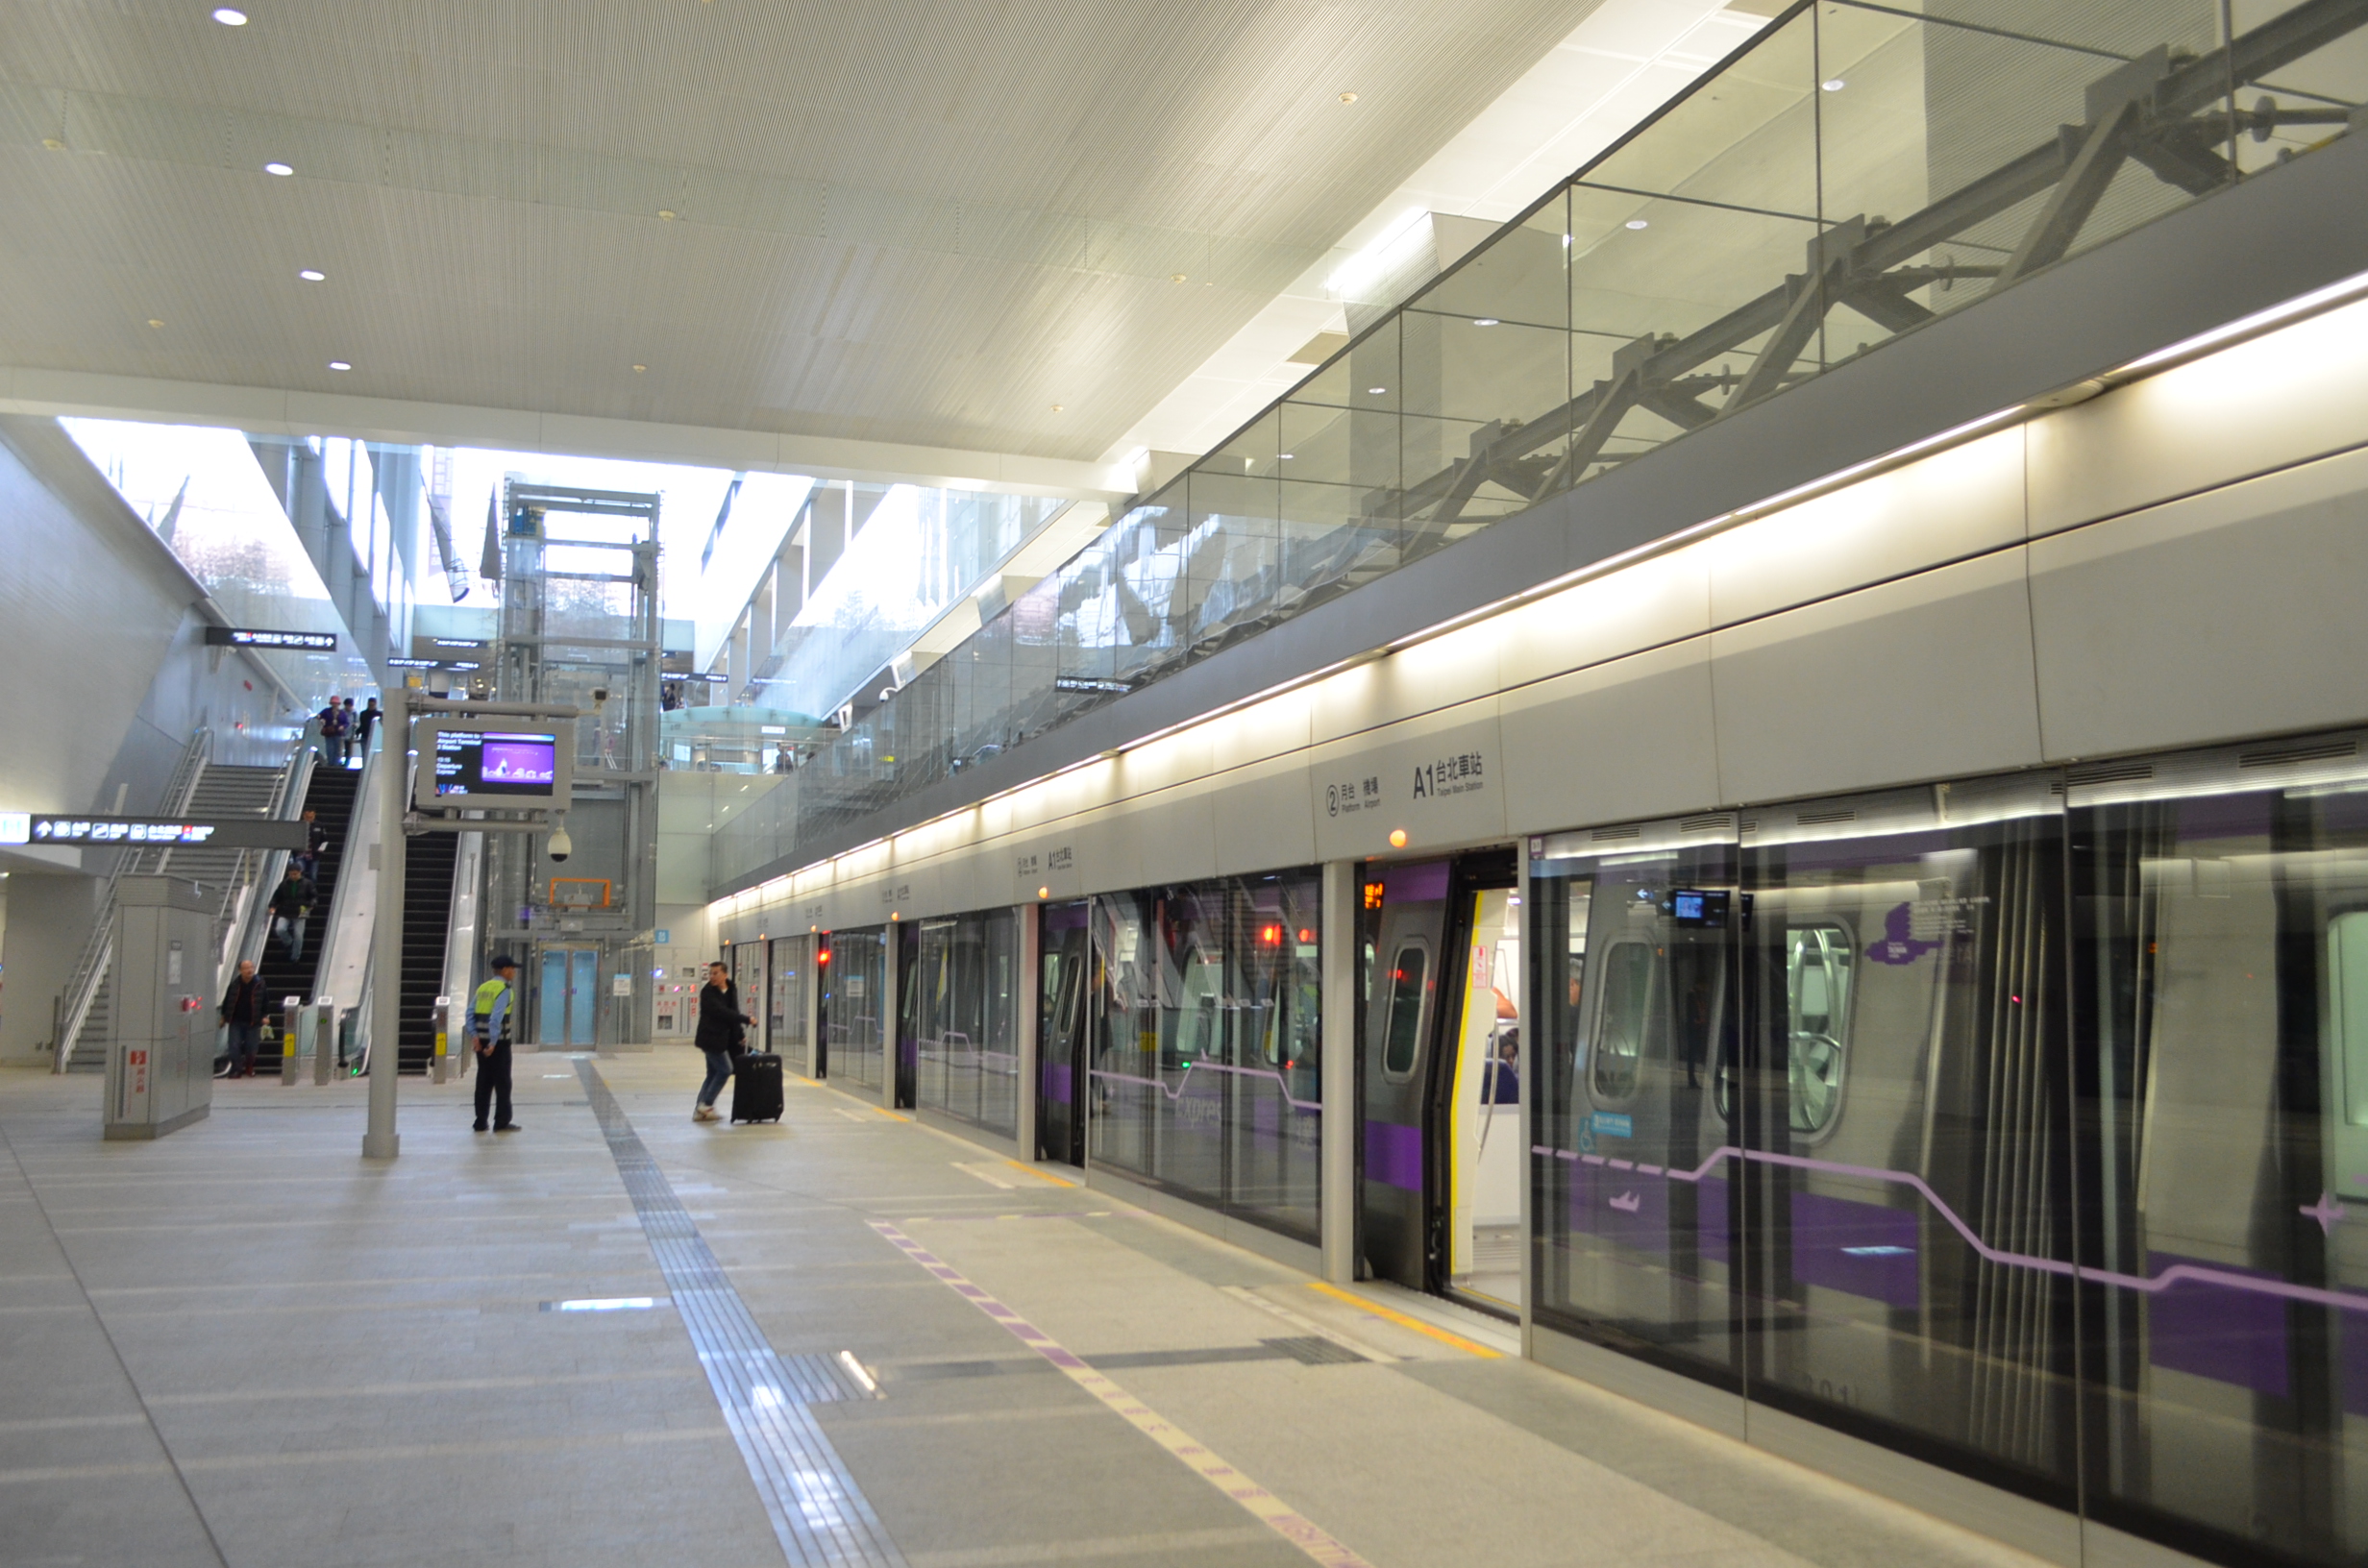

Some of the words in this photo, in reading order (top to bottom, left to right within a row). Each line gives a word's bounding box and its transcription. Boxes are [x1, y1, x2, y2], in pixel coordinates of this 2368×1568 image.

[1414, 764, 1434, 799] A1
[1436, 751, 1483, 784] 台北車站
[1342, 783, 1355, 801] 月台
[1437, 788, 1451, 798] Taipei
[1452, 785, 1465, 795] Main
[1466, 781, 1484, 792] Station
[1342, 803, 1361, 814] Platform
[1365, 798, 1381, 810] Airport
